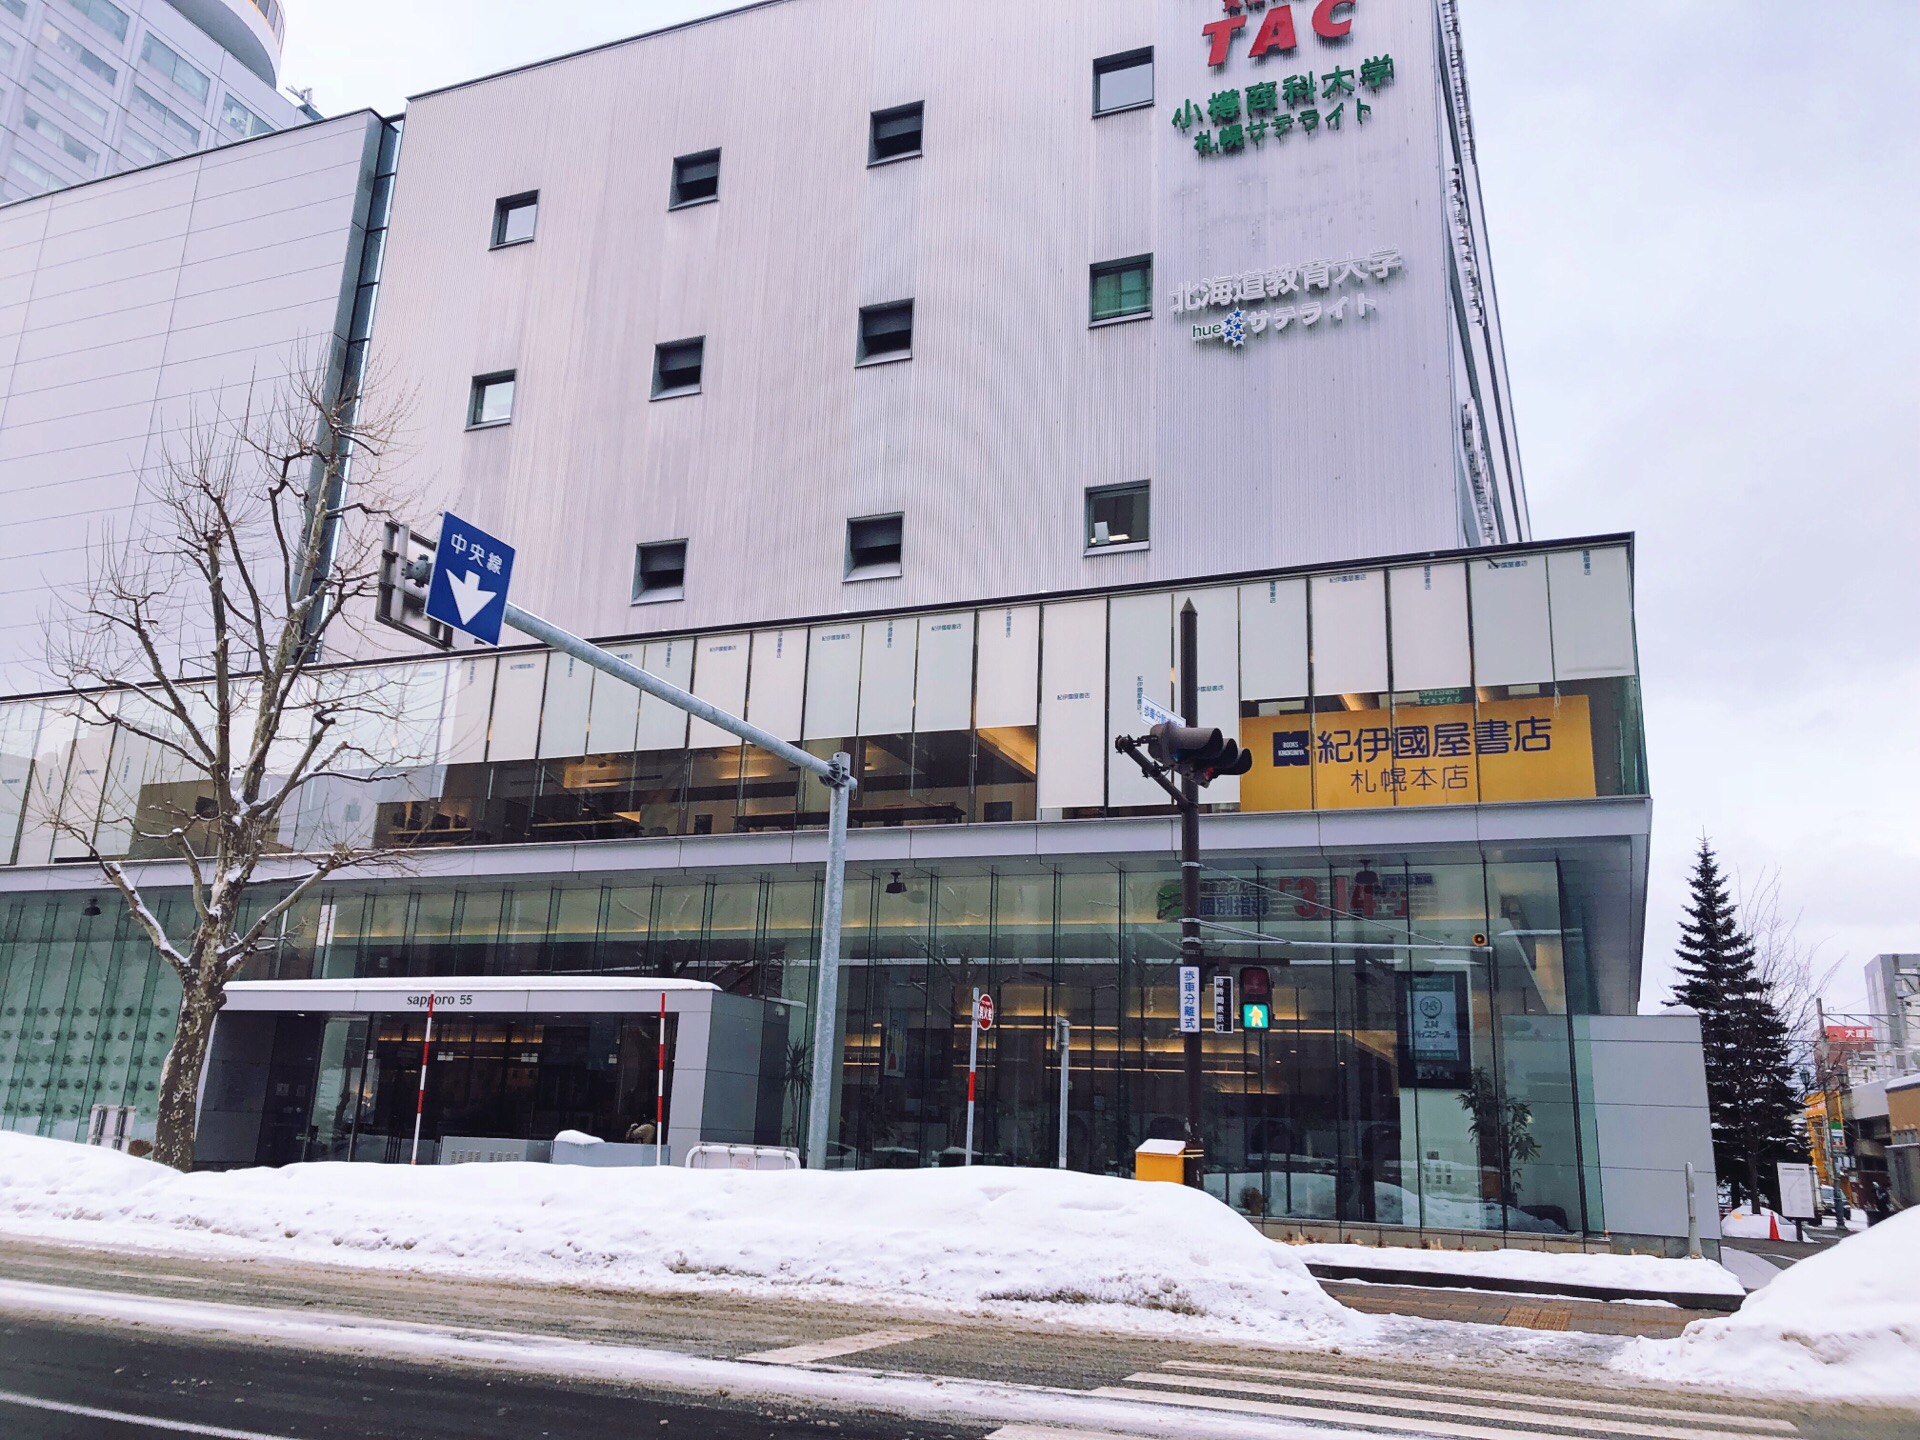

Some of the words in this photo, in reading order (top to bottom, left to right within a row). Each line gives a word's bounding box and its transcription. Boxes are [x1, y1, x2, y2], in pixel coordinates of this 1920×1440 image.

[1202, 0, 1352, 67] TAC
[1171, 54, 1394, 129] 小樽商科大学
[1194, 98, 1371, 152] 札幌サテライト
[1169, 247, 1402, 313] 北海道教育大学
[1192, 322, 1222, 341] hue
[1247, 293, 1376, 333] サテライト
[451, 533, 503, 575] 中央線
[1317, 716, 1552, 763] 紀伊國屋書店
[1350, 764, 1469, 793] 札幌本店
[459, 994, 473, 1005] 55
[1184, 970, 1196, 1029] 歩車分離式
